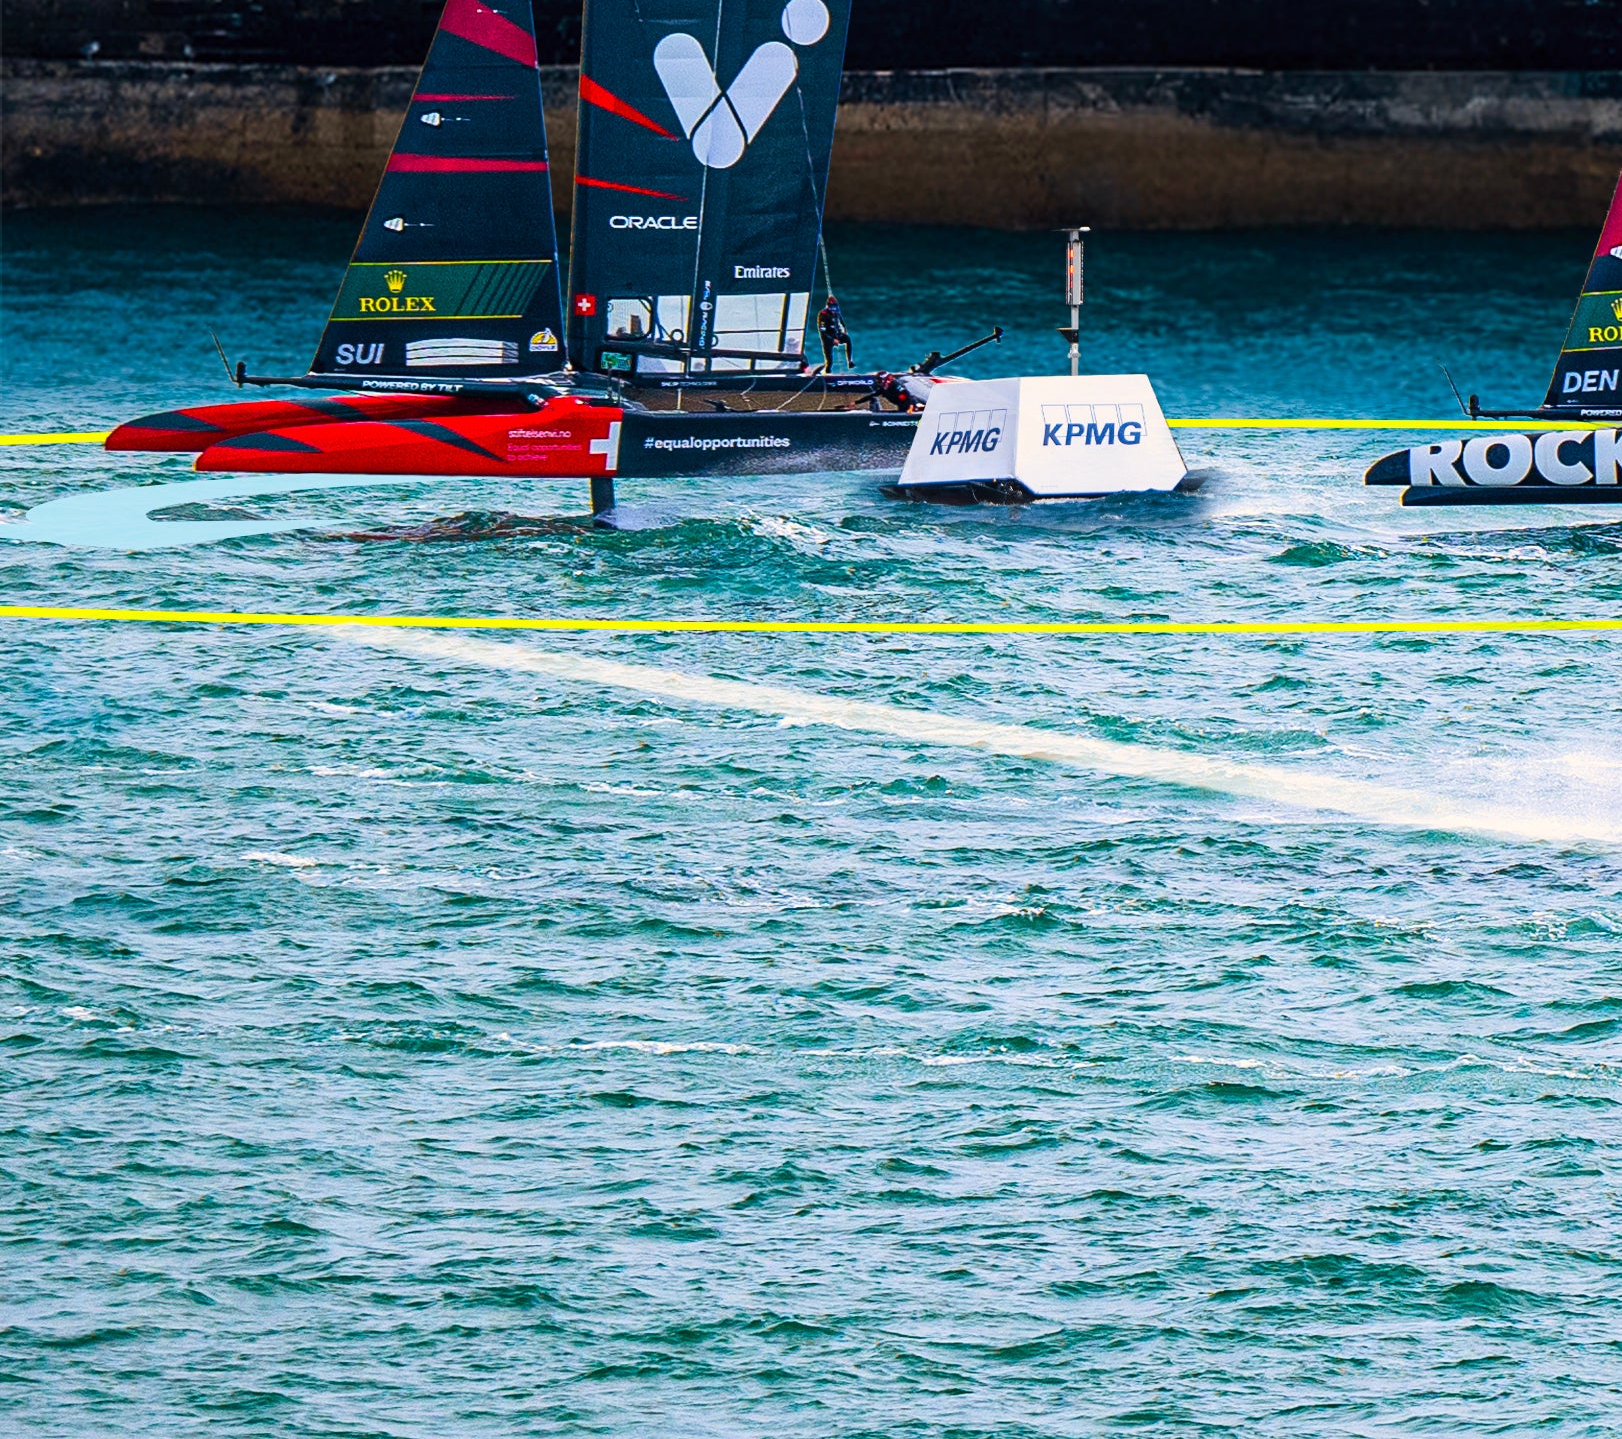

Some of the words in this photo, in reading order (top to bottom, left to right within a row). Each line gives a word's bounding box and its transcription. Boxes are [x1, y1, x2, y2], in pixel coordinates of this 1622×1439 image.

[610, 216, 698, 229] ORACLE
[734, 266, 790, 279] Emirates
[359, 297, 436, 312] ROLEX
[335, 343, 384, 364] SUI
[363, 380, 418, 390] POWERED
[420, 382, 435, 391] BY
[437, 384, 463, 392] TILT
[1562, 369, 1619, 394] DEN
[930, 427, 1001, 455] KPMG
[1043, 421, 1141, 446] KPMG
[645, 435, 790, 450] #equalopportunities
